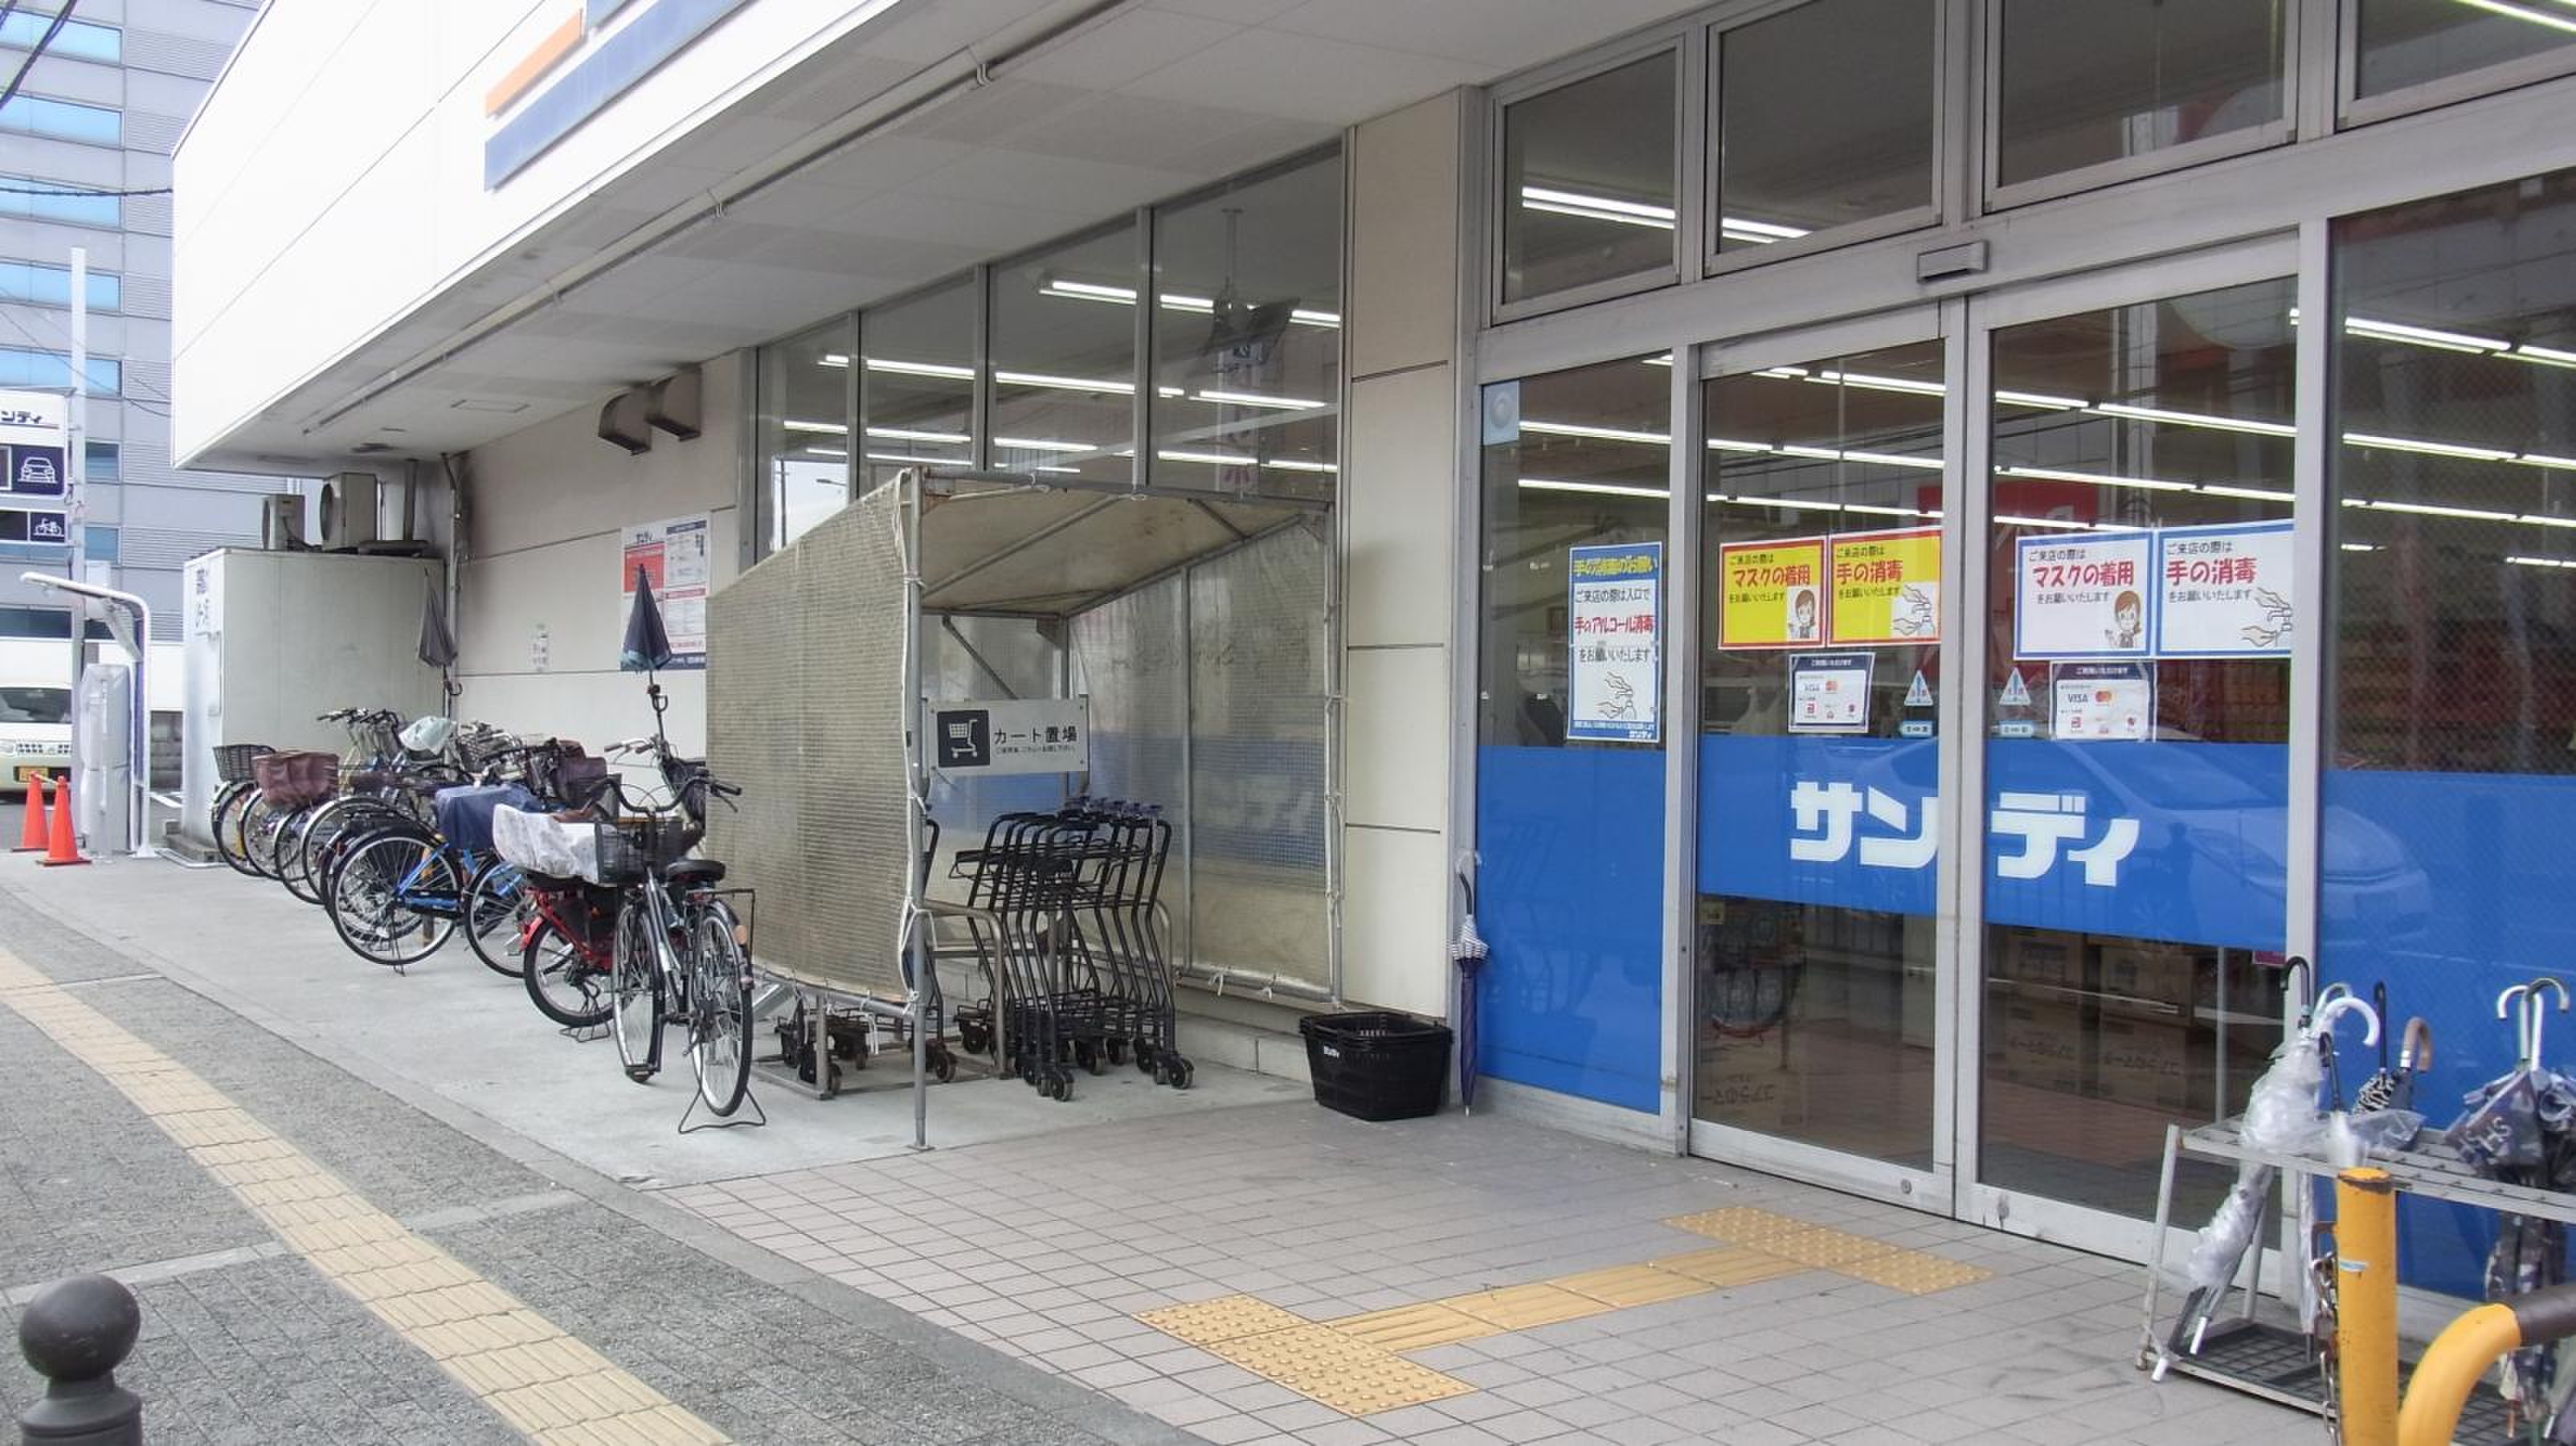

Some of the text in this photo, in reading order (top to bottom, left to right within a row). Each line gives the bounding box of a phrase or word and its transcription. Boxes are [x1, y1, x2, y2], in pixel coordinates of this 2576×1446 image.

[2029, 549, 2087, 562] ご来店の際は
[2167, 541, 2233, 554] ご来店の際は
[1734, 564, 1810, 587] マスクの着用
[1837, 560, 1903, 585] 手の消毒
[2033, 560, 2134, 587] マスクの着用
[2166, 558, 2257, 586] 手の消毒
[994, 726, 1077, 745] カート置場
